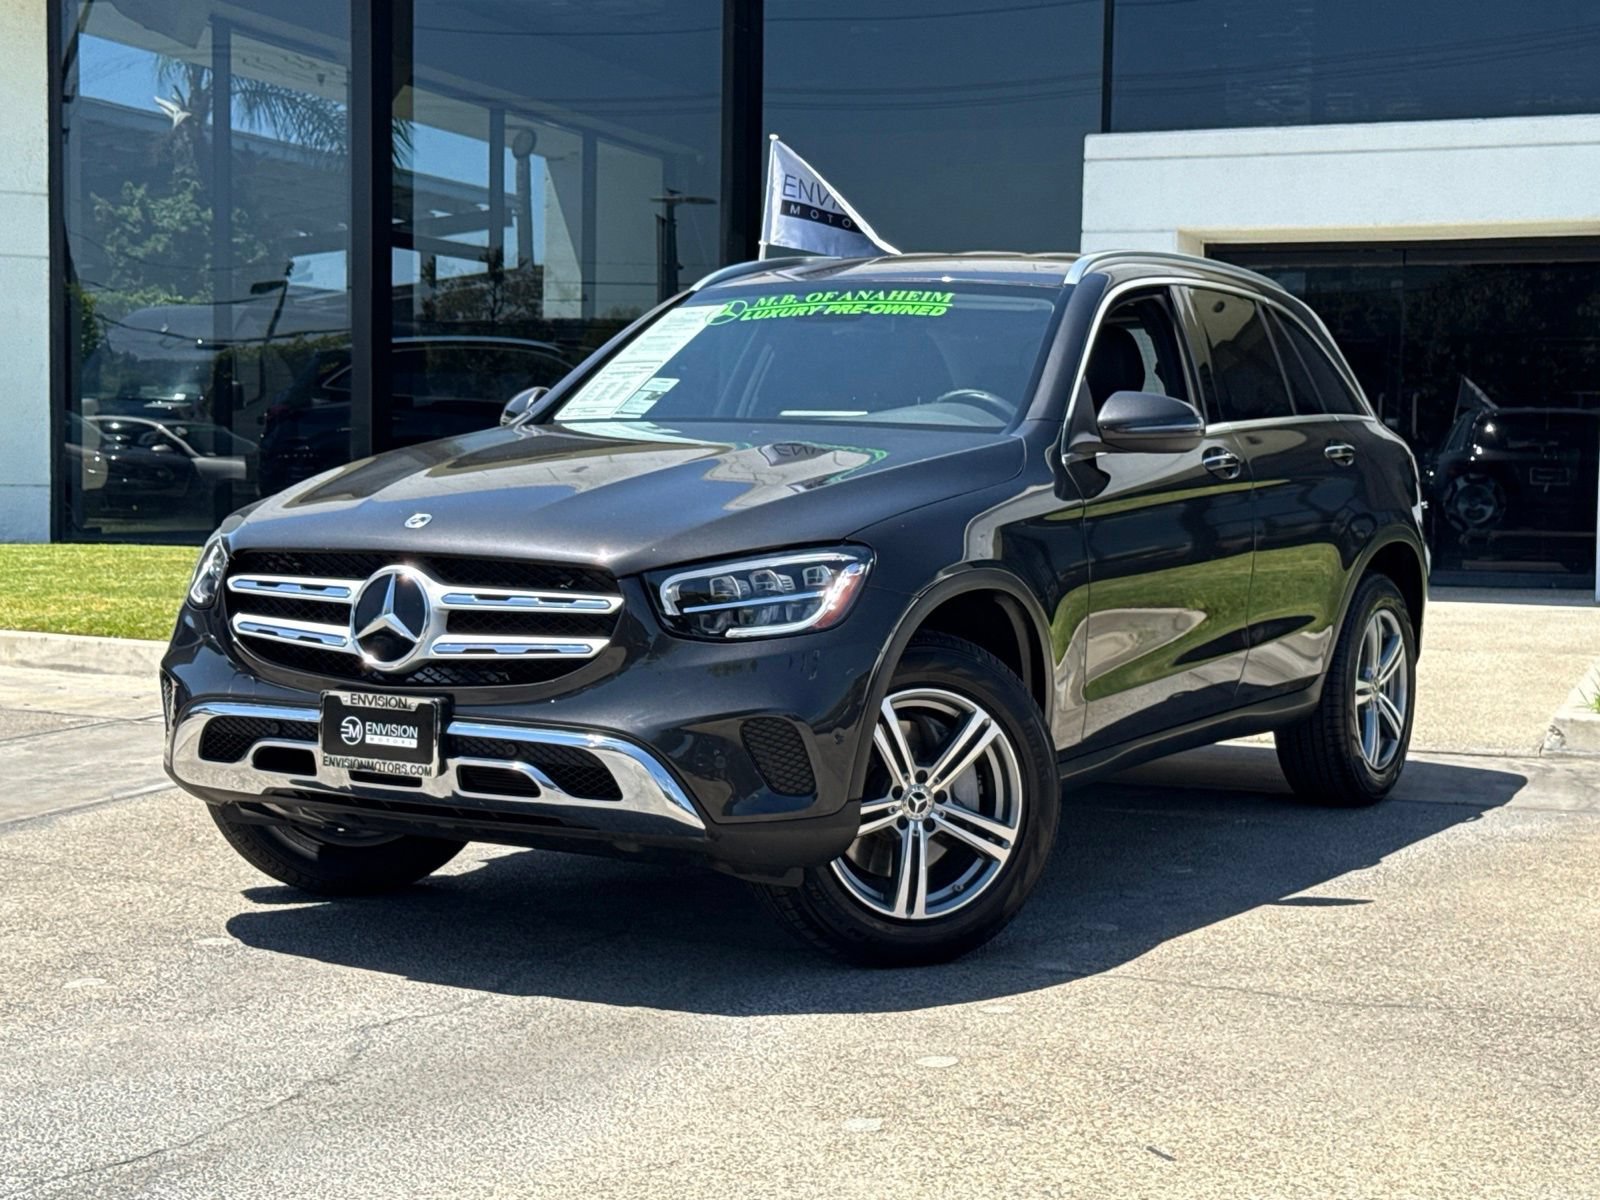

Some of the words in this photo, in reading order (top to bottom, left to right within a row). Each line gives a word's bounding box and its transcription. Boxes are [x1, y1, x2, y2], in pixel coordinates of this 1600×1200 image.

[790, 204, 852, 228] MOTO
[753, 294, 798, 308] M.B.
[805, 291, 838, 303] OF
[837, 290, 955, 303] ANAHEIM
[740, 305, 823, 321] LUXURY
[823, 303, 947, 316] PRE-OWNED
[350, 693, 407, 710] ENVISION
[365, 721, 418, 738] ENVISION
[322, 755, 432, 777] ENVISIONMOTORS.COM
